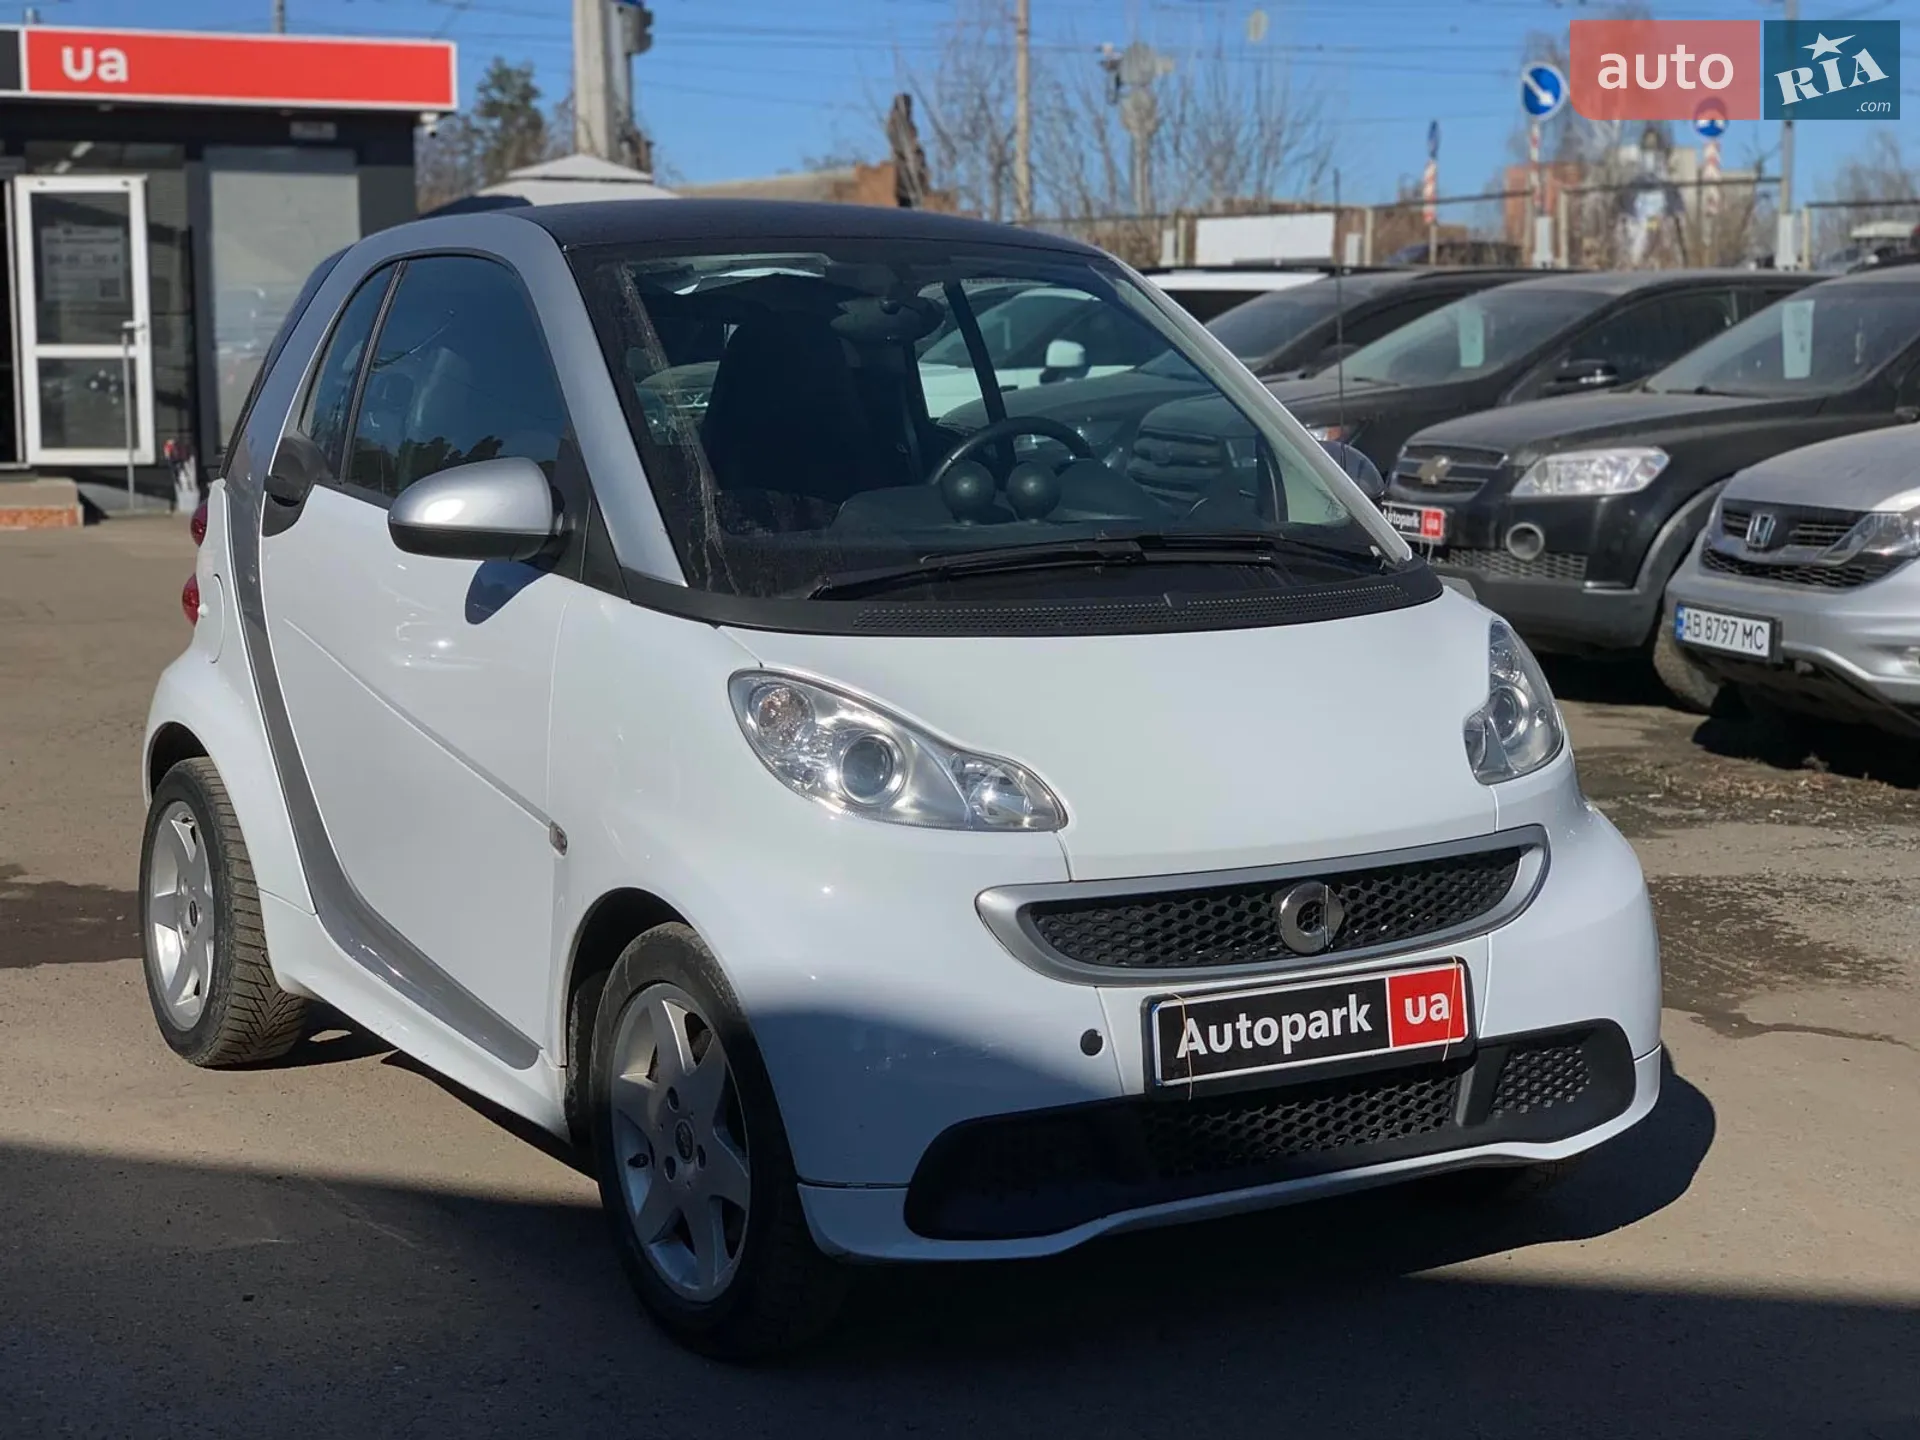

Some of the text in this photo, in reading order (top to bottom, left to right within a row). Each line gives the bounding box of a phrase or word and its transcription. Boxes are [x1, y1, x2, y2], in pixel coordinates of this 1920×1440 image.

[61, 45, 129, 83] ua
[1704, 616, 1738, 647] 8797
[1741, 623, 1765, 650] MC
[1176, 992, 1451, 1059] Autopark ua
